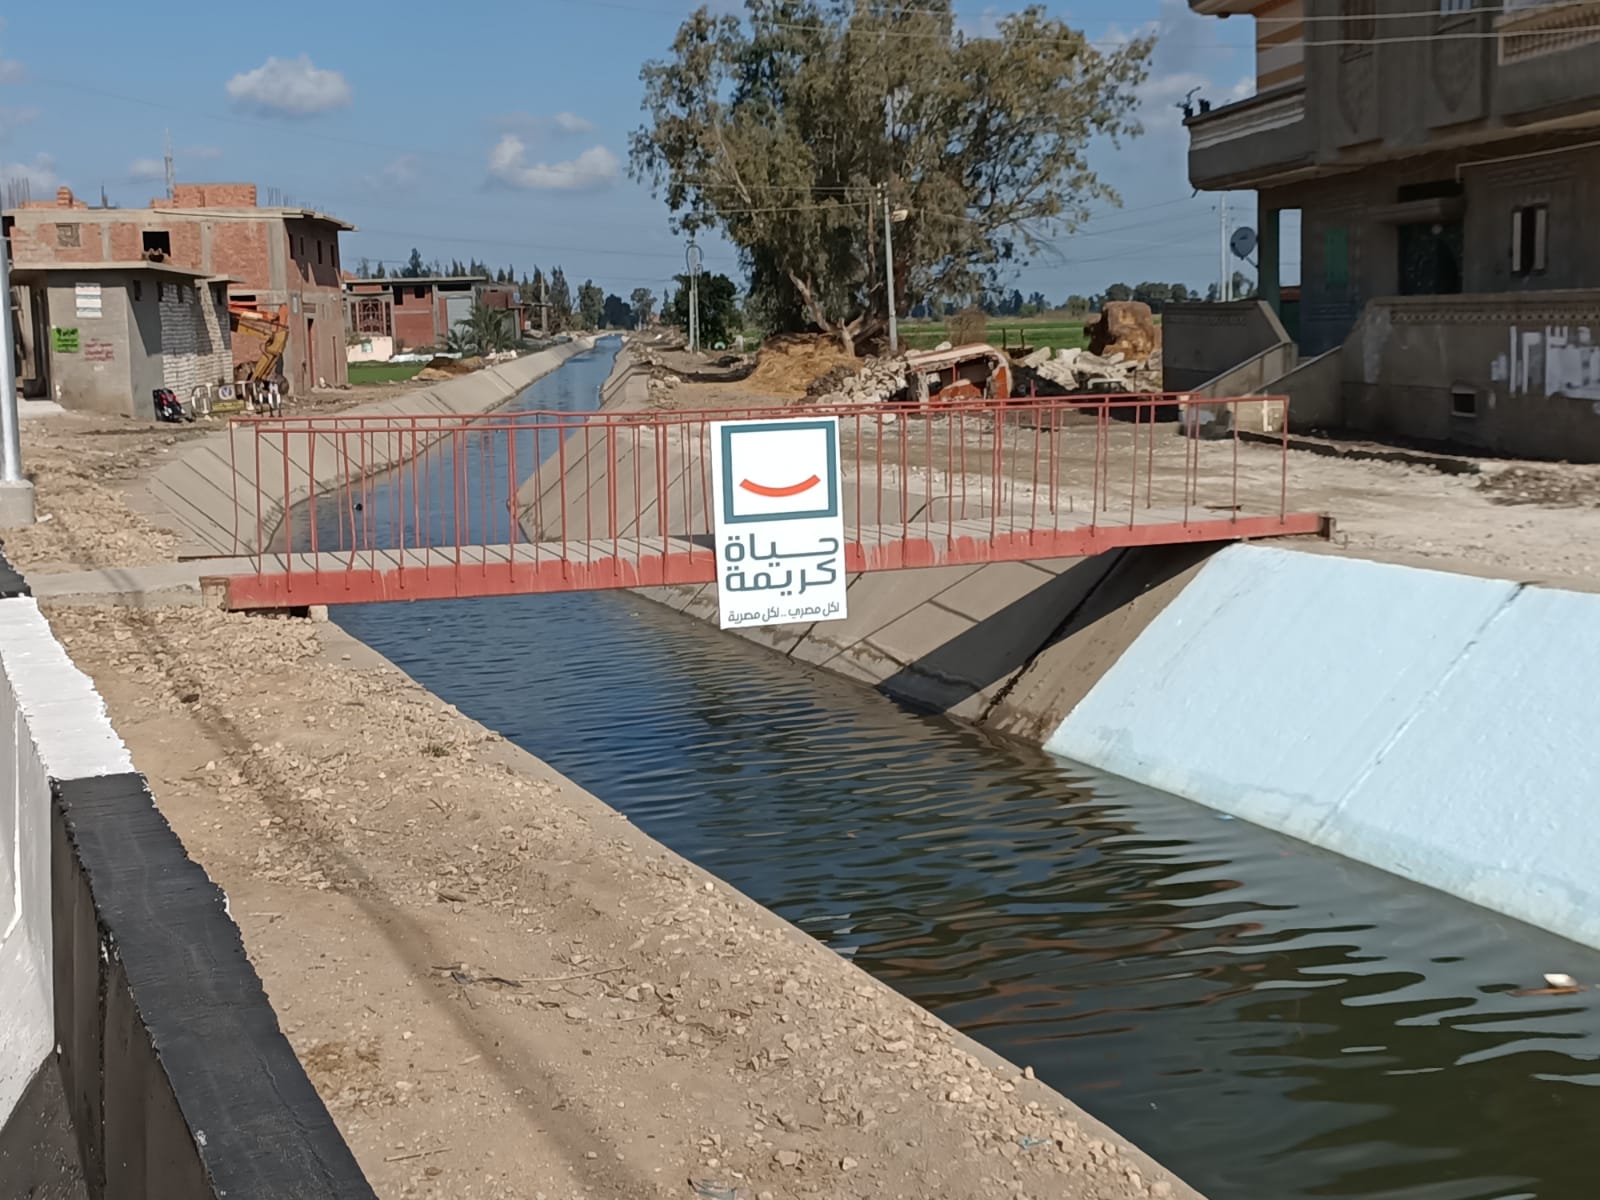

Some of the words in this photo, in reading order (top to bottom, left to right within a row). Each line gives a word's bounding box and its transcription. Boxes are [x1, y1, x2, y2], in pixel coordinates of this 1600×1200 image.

[725, 533, 839, 567] حياة
[726, 558, 836, 596] كريمة
[761, 606, 780, 622] لكل
[788, 606, 821, 619] مصري
[823, 602, 840, 617] لكل
[728, 612, 760, 624] مصرية
